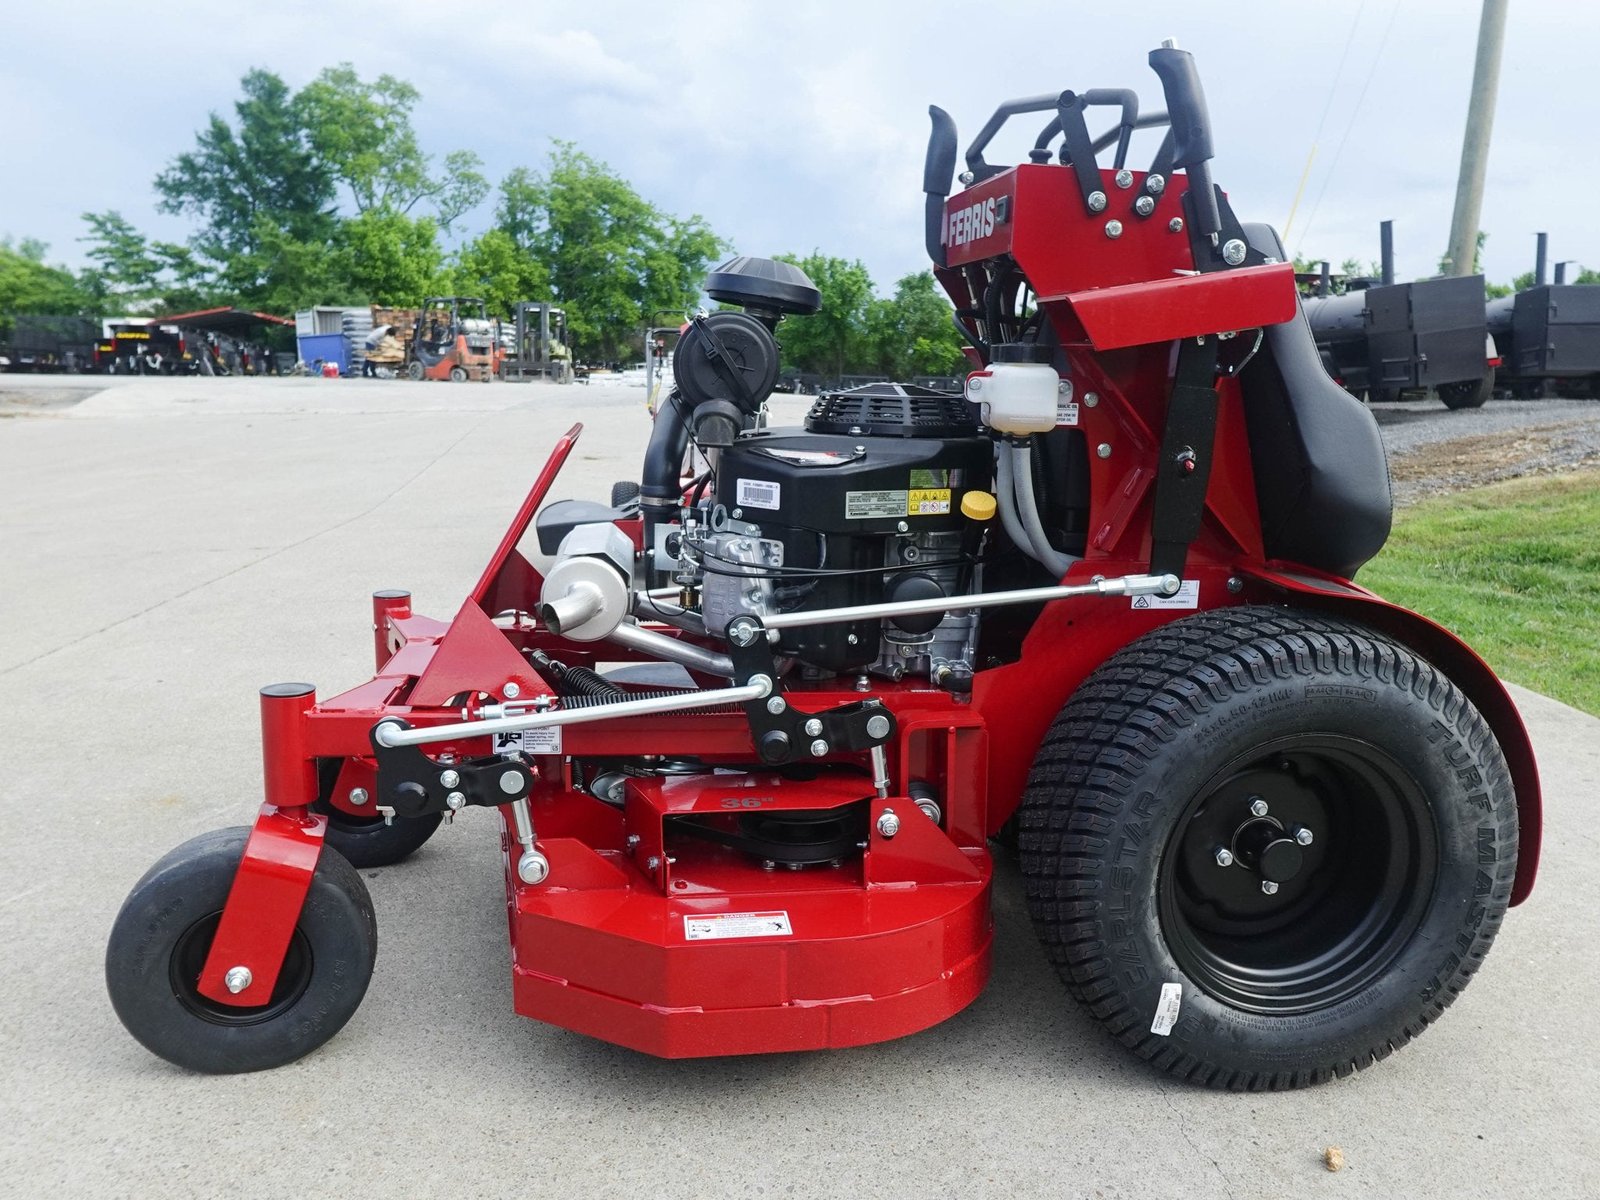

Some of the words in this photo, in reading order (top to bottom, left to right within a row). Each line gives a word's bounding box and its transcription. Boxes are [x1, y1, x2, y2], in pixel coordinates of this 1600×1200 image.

[948, 196, 996, 248] FERRIS
[1426, 719, 1493, 814] TURF
[1109, 790, 1155, 988] EARLSTAR
[1419, 826, 1497, 1005] MASTER
